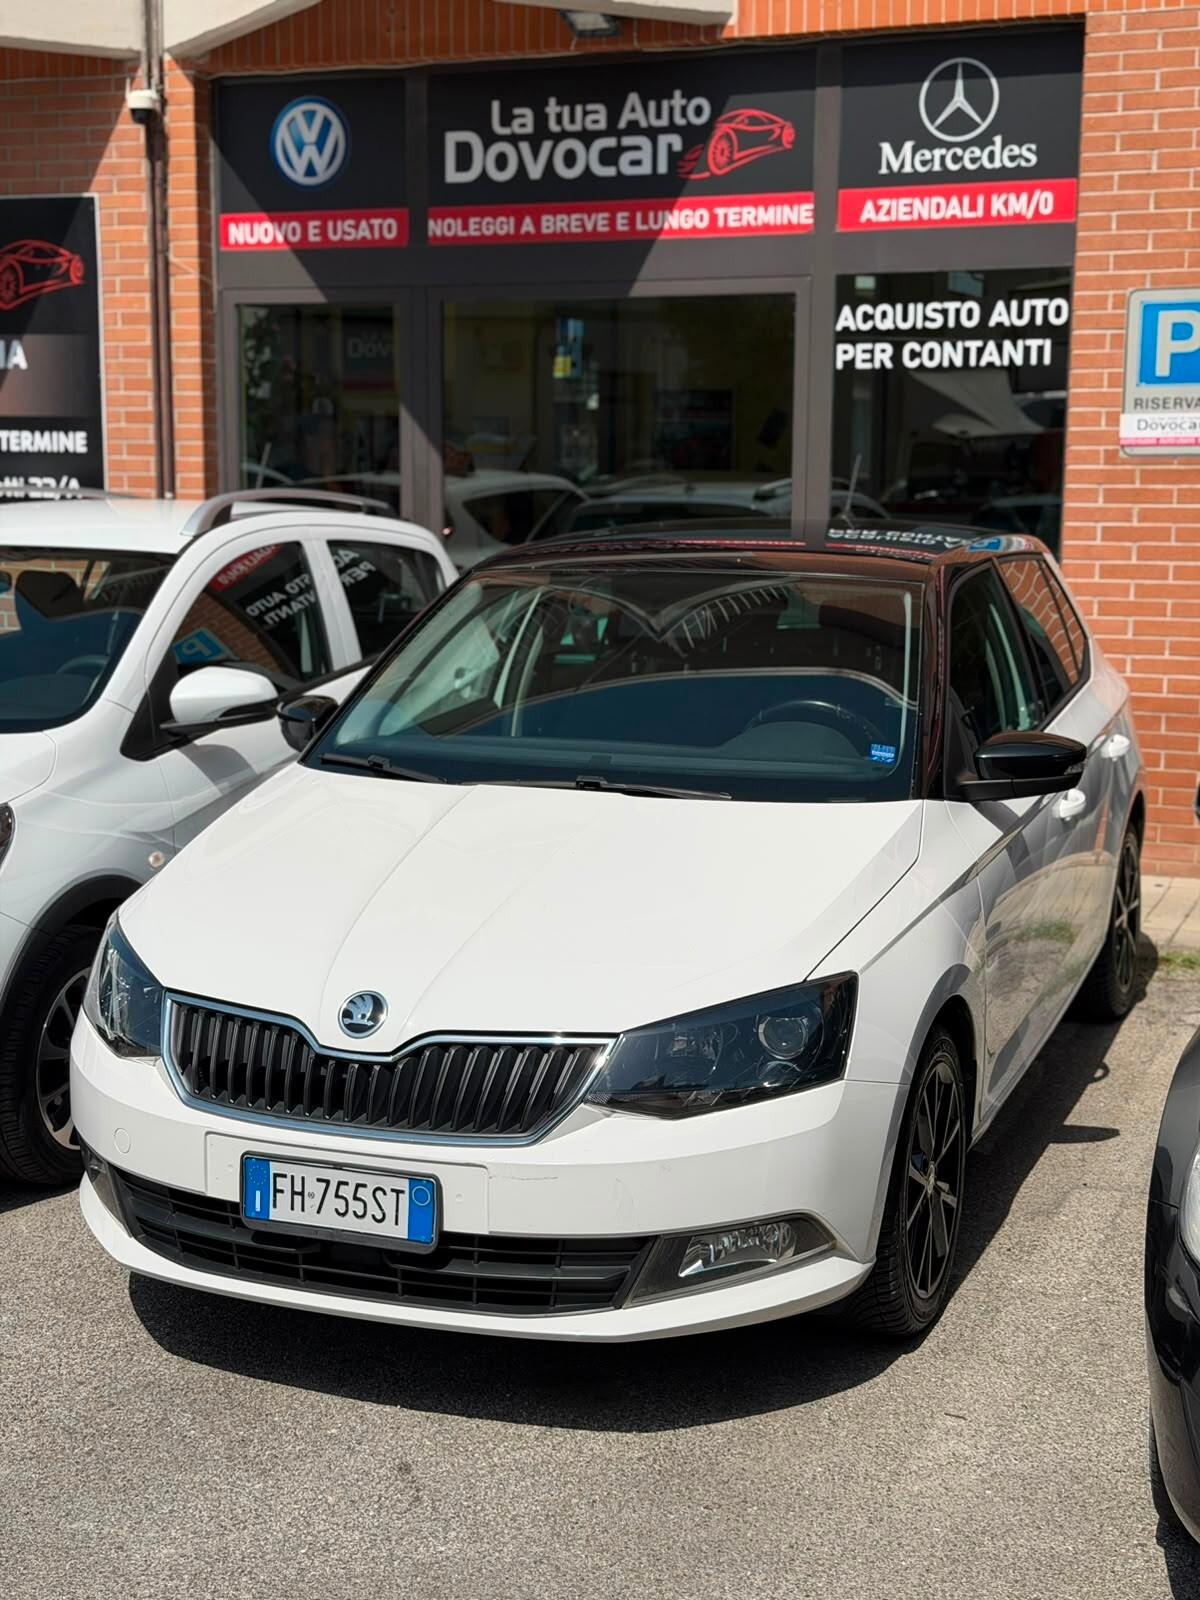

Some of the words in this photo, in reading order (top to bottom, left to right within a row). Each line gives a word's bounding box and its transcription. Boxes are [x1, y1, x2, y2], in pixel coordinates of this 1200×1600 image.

[491, 99, 535, 136] La
[544, 97, 608, 133] tua
[616, 89, 712, 130] Auto
[444, 133, 683, 184] Dovocar
[877, 134, 1038, 175] Mercedes
[427, 216, 516, 237] NOLEGGI
[519, 216, 536, 235] A
[540, 212, 611, 234] BREVE
[616, 212, 630, 231] E
[636, 208, 711, 231] LUNGO
[713, 203, 815, 228] TERMINE
[860, 194, 984, 223] AZIENDALI
[990, 189, 1054, 219] KM/0
[228, 220, 301, 246] NUOVO
[307, 221, 322, 242] E
[327, 218, 398, 242] USATO
[835, 301, 981, 332] ACQUISTO
[988, 297, 1070, 328] AUTO
[835, 342, 894, 370] PER
[901, 338, 1052, 369] CONTANTI
[1155, 310, 1200, 377] P
[0, 430, 88, 454] TERMINE
